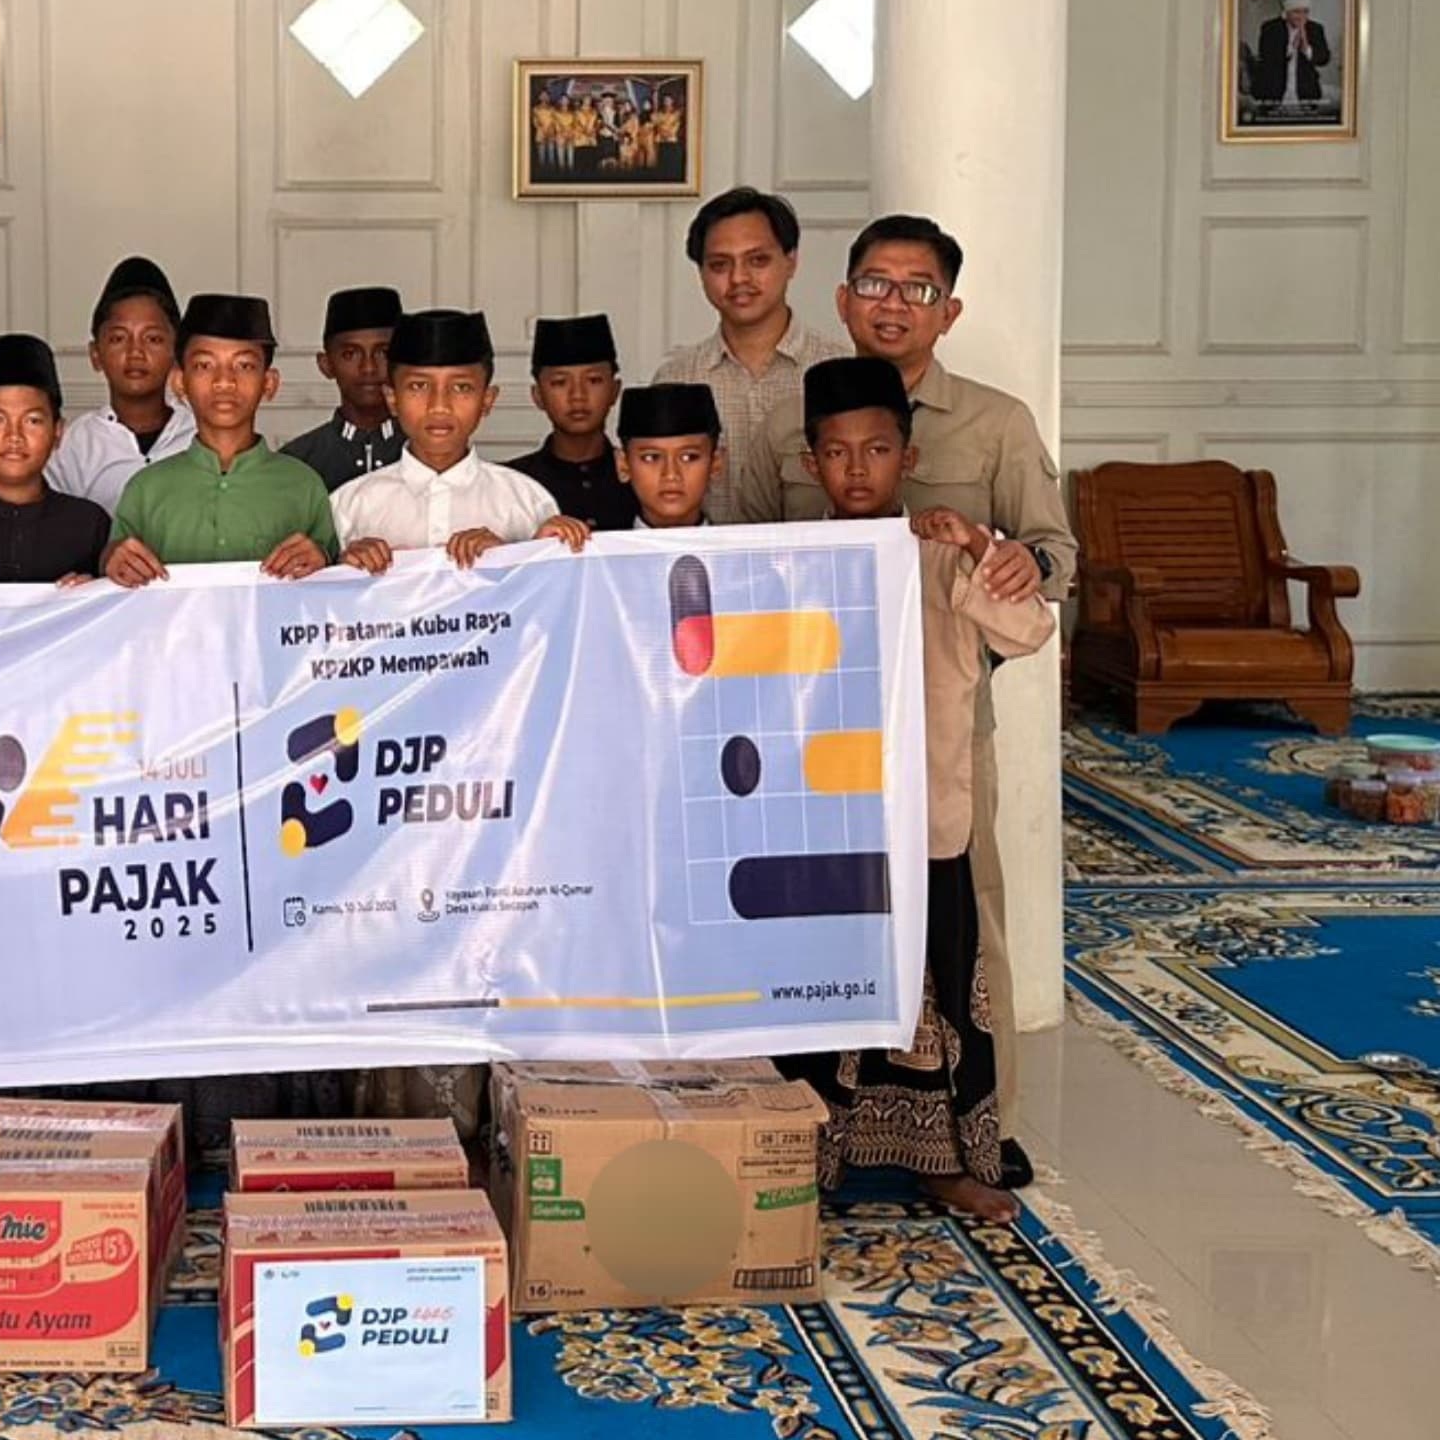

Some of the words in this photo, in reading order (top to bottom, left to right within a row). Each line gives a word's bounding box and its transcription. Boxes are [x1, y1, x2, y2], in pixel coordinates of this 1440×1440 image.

[280, 625, 320, 647] KPP
[325, 621, 406, 644] Pratama
[411, 615, 460, 638] Kubu
[465, 610, 512, 635] Raya
[381, 646, 490, 677] Mempawah
[163, 755, 208, 780] JULI
[375, 735, 447, 777] DJP
[92, 790, 211, 846] HARI
[378, 780, 515, 826] PEDULI
[58, 857, 222, 917] PAJAK
[771, 981, 877, 1001] www.pajak.go.id
[26, 1311, 92, 1337] Ayam
[361, 1308, 407, 1325] DJP
[362, 1327, 449, 1345] PEDULI
